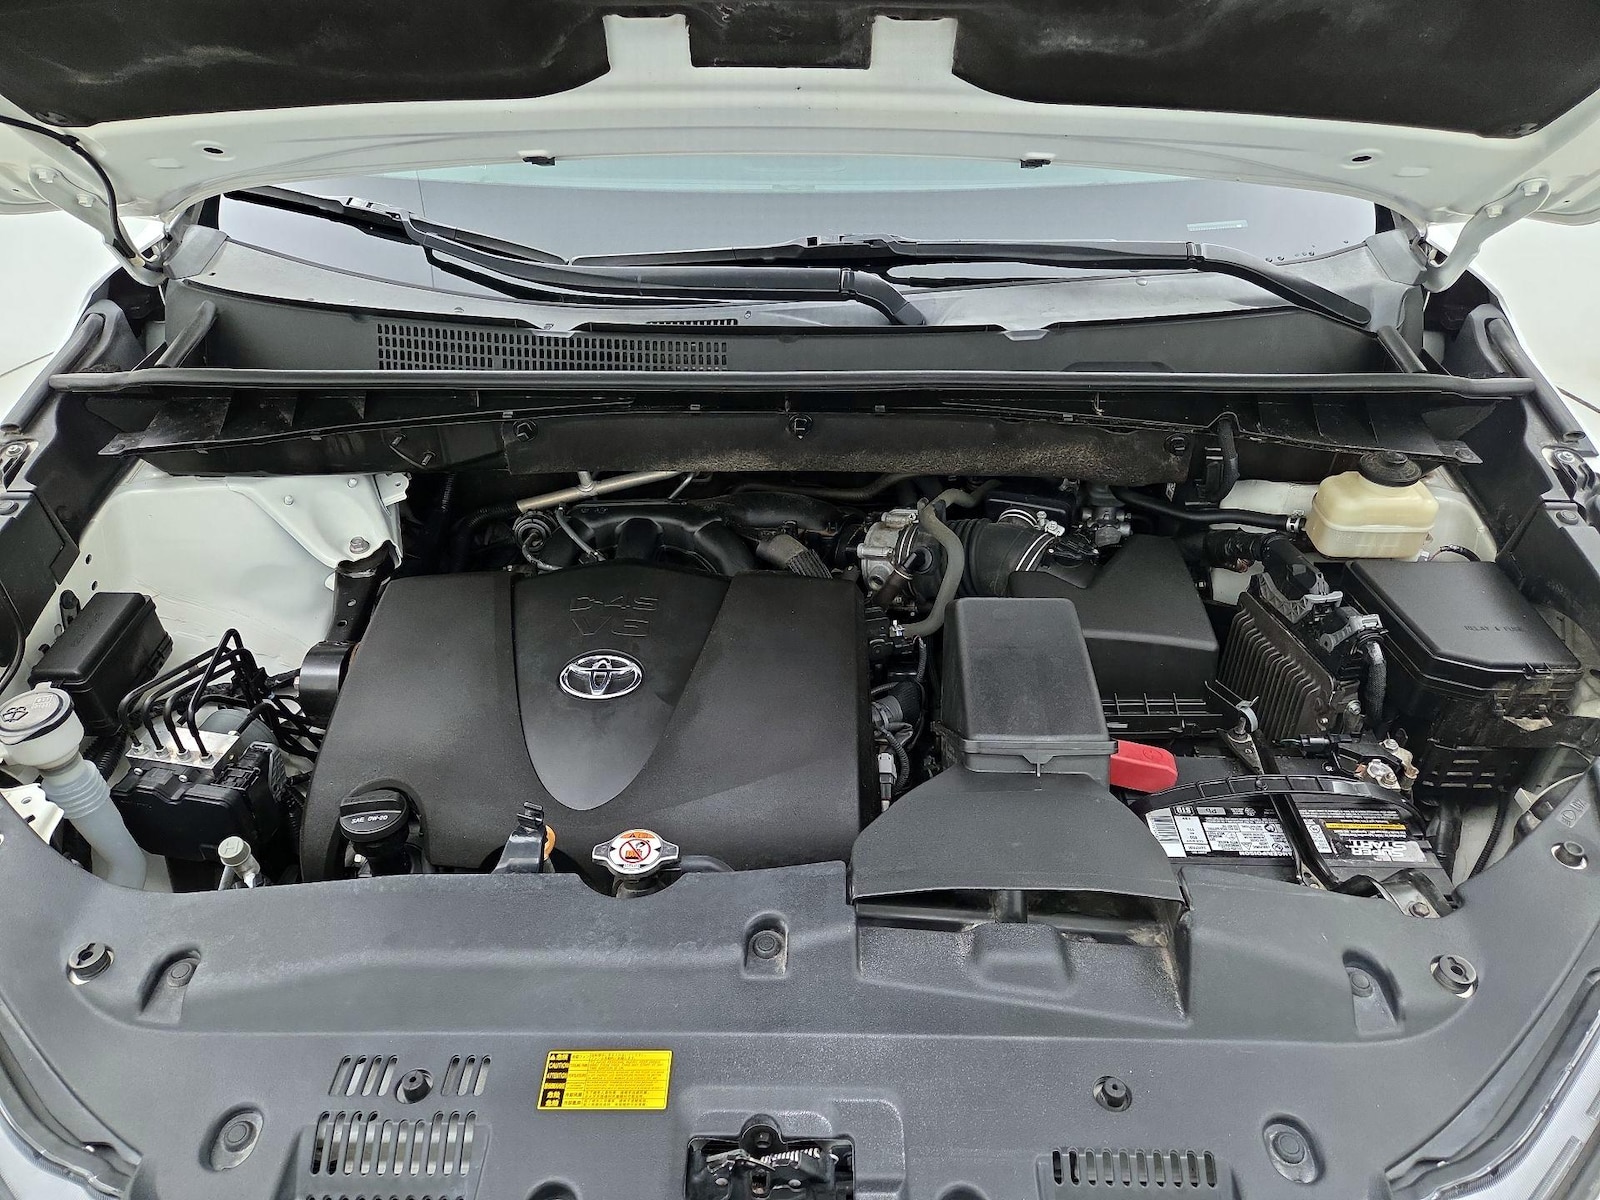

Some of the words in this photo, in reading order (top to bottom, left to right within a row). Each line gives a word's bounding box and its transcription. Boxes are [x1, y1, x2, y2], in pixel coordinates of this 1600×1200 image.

[571, 615, 650, 637] V6
[1348, 840, 1407, 851] START
[1351, 848, 1404, 858] SUPER
